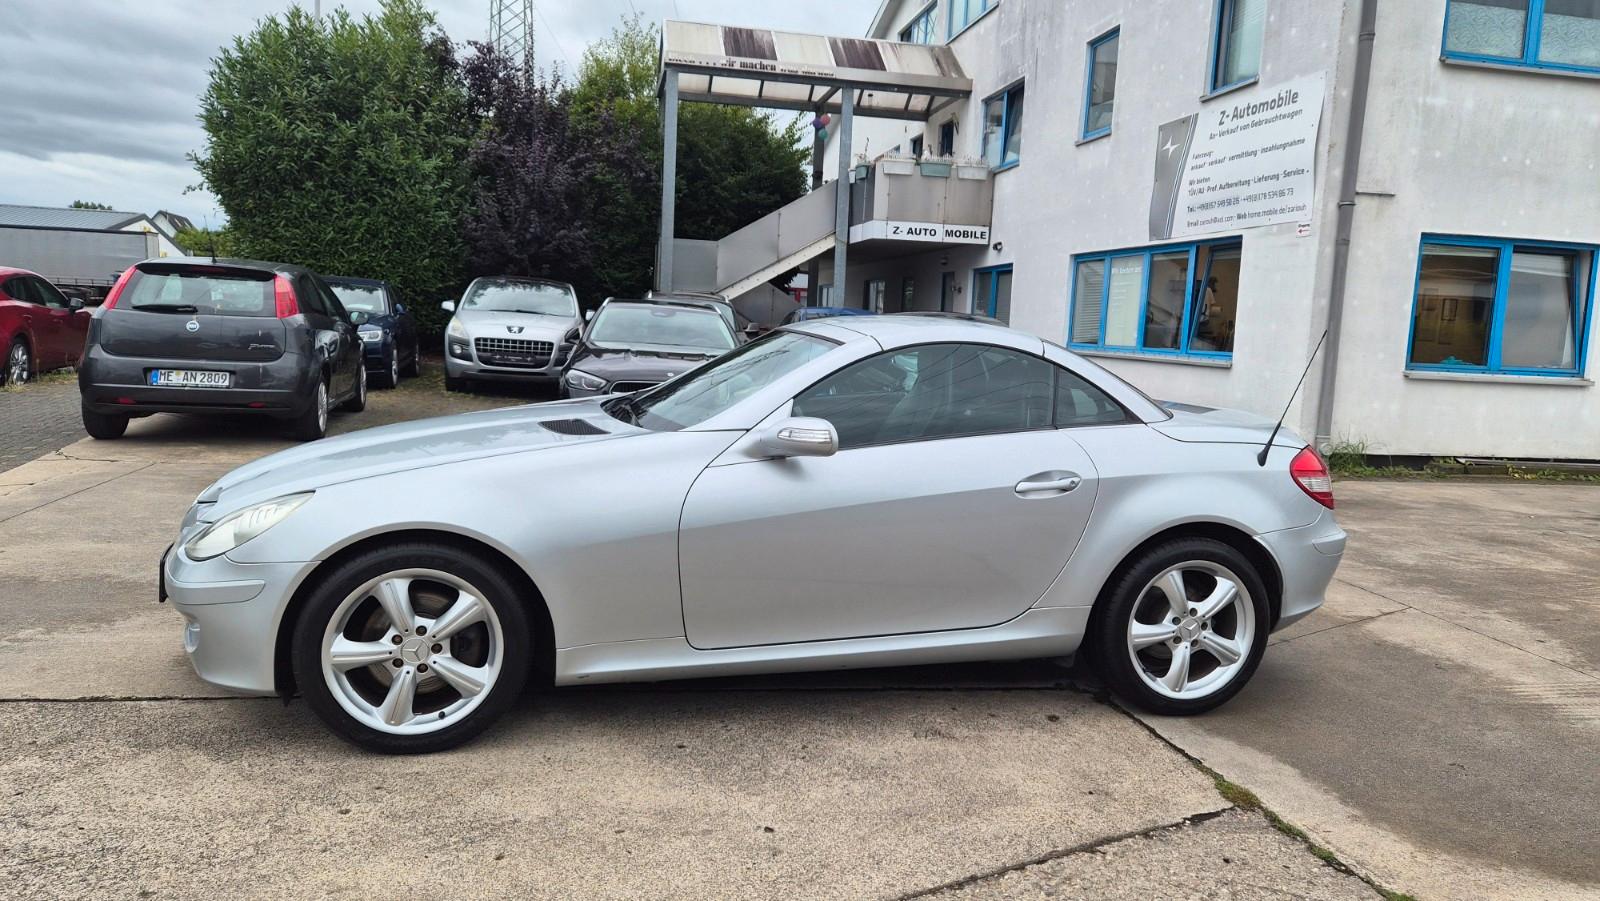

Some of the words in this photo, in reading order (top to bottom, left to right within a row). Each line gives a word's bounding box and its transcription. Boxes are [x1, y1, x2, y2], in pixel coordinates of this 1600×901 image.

[740, 60, 776, 72] machen
[1218, 110, 1230, 126] Z-
[1230, 88, 1299, 122] Automobile
[1218, 124, 1239, 138] Verkauf
[1240, 124, 1250, 132] von
[1250, 108, 1303, 129] Gebrauchtwagen
[1253, 172, 1280, 184] Lieferung
[1282, 168, 1305, 178] Service
[893, 226, 903, 234] Z-
[907, 227, 936, 236] AUTO
[945, 230, 987, 240] MOBILE
[160, 370, 174, 382] ME
[182, 372, 198, 382] AN
[200, 372, 228, 384] 2809
